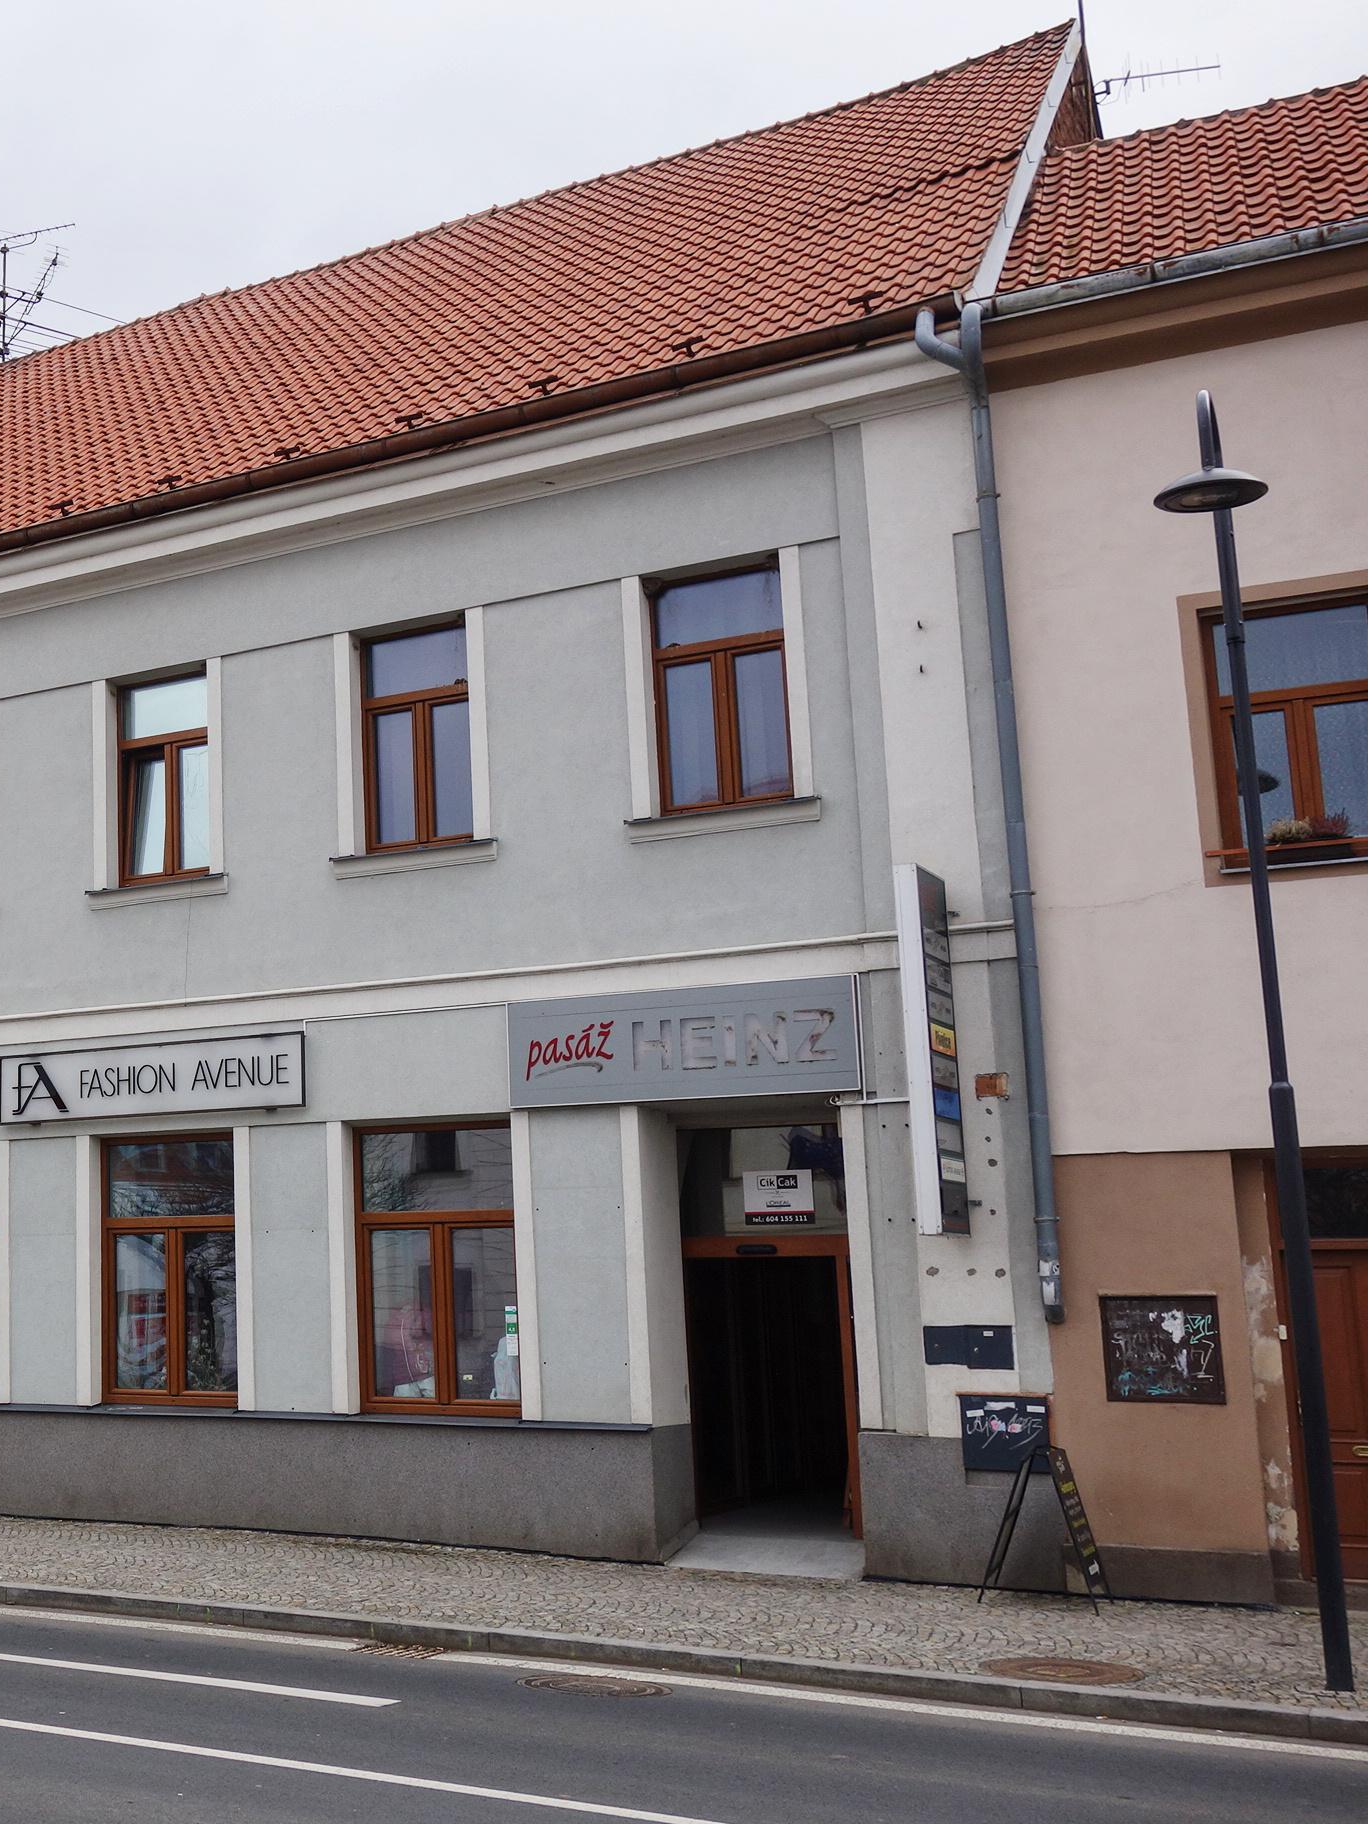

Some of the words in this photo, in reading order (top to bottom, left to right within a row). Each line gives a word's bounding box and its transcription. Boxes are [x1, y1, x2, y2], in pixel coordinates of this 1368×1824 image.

[525, 1020, 615, 1081] pasáž
[632, 1008, 838, 1072] HEINZ
[80, 1062, 176, 1099] FASHION
[191, 1053, 290, 1092] AVENUE
[778, 1177, 797, 1187] Cak
